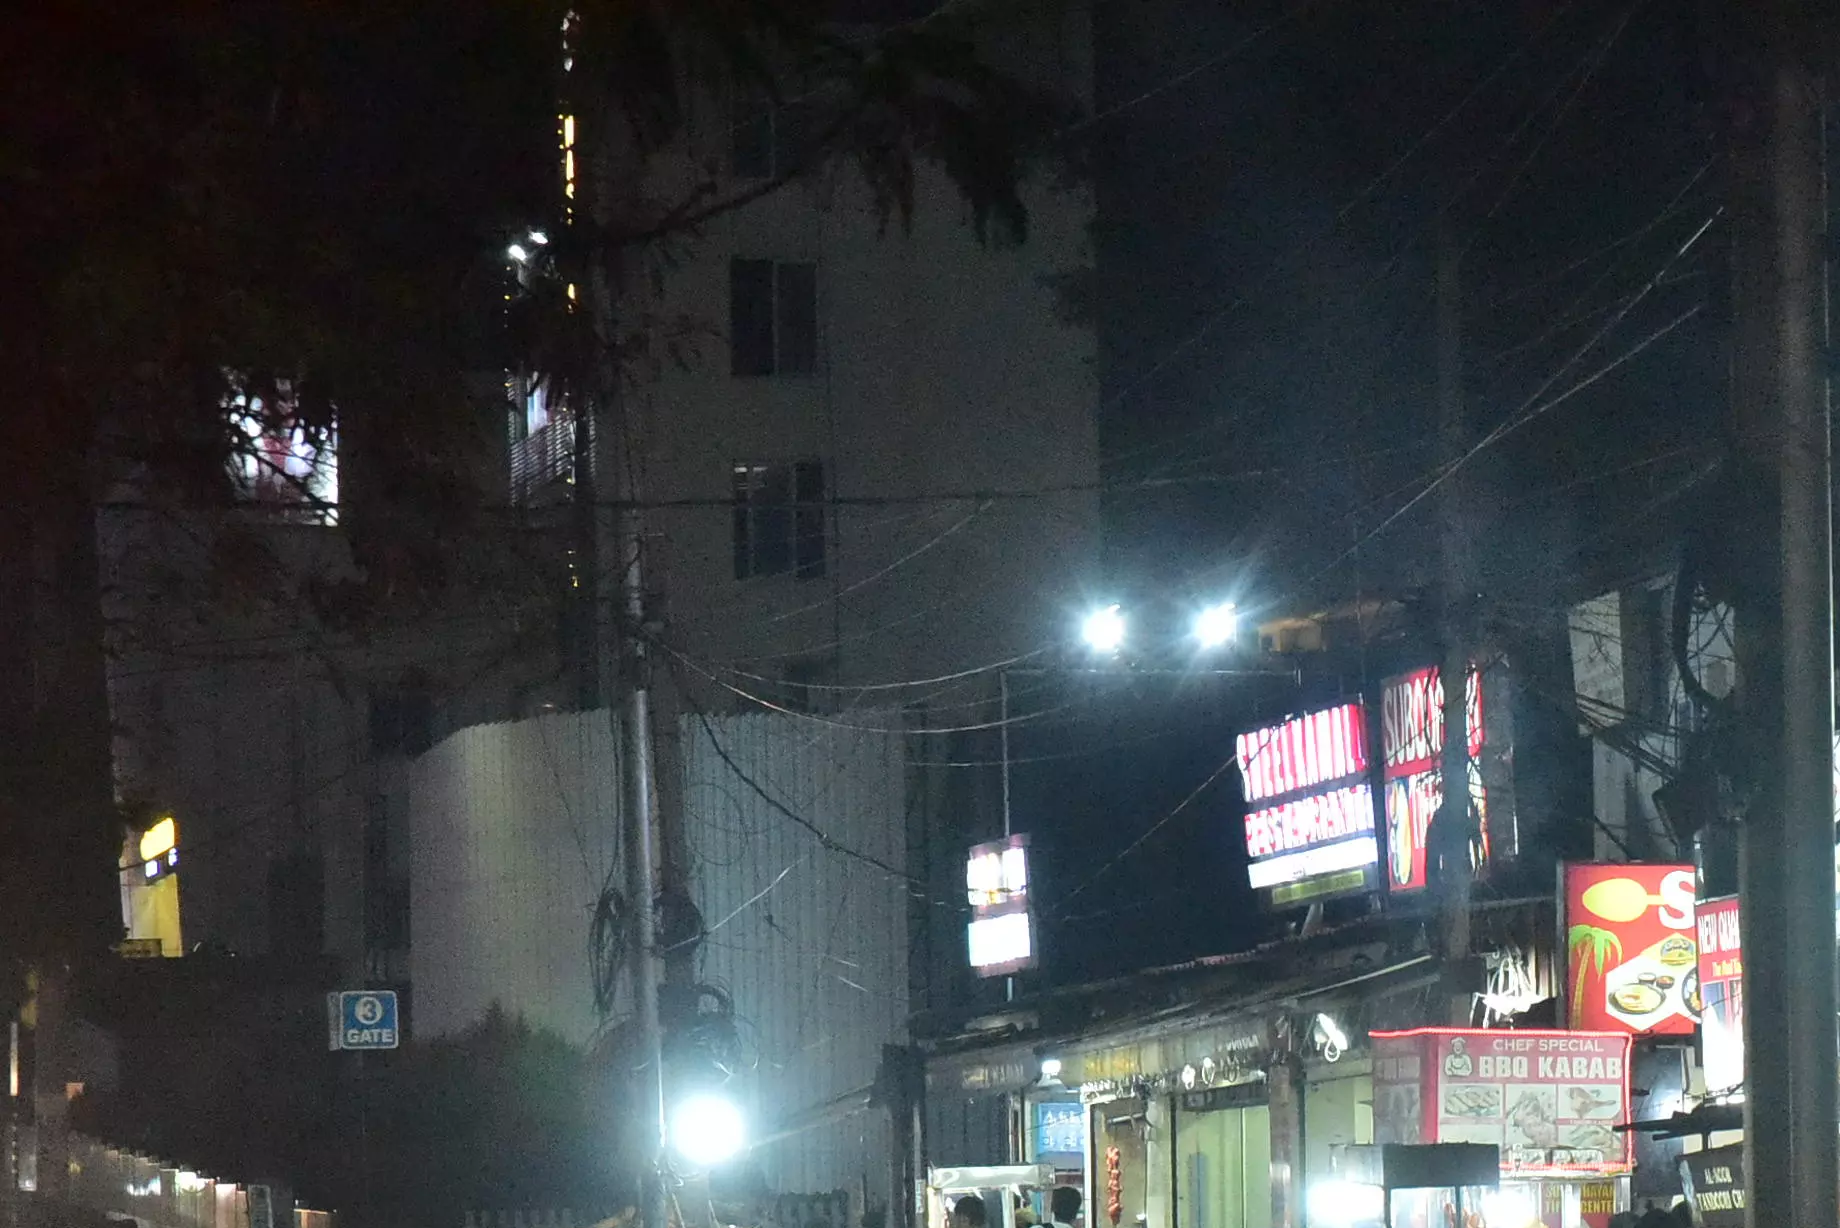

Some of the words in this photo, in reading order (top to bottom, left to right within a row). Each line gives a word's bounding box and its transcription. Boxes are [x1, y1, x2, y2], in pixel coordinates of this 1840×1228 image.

[363, 1000, 377, 1019] 3
[347, 1028, 394, 1043] GATE
[1493, 1038, 1536, 1052] CHEF
[1538, 1038, 1604, 1053] SPECIAL
[1479, 1055, 1529, 1079] BBQ
[1538, 1055, 1622, 1080] KABAB
